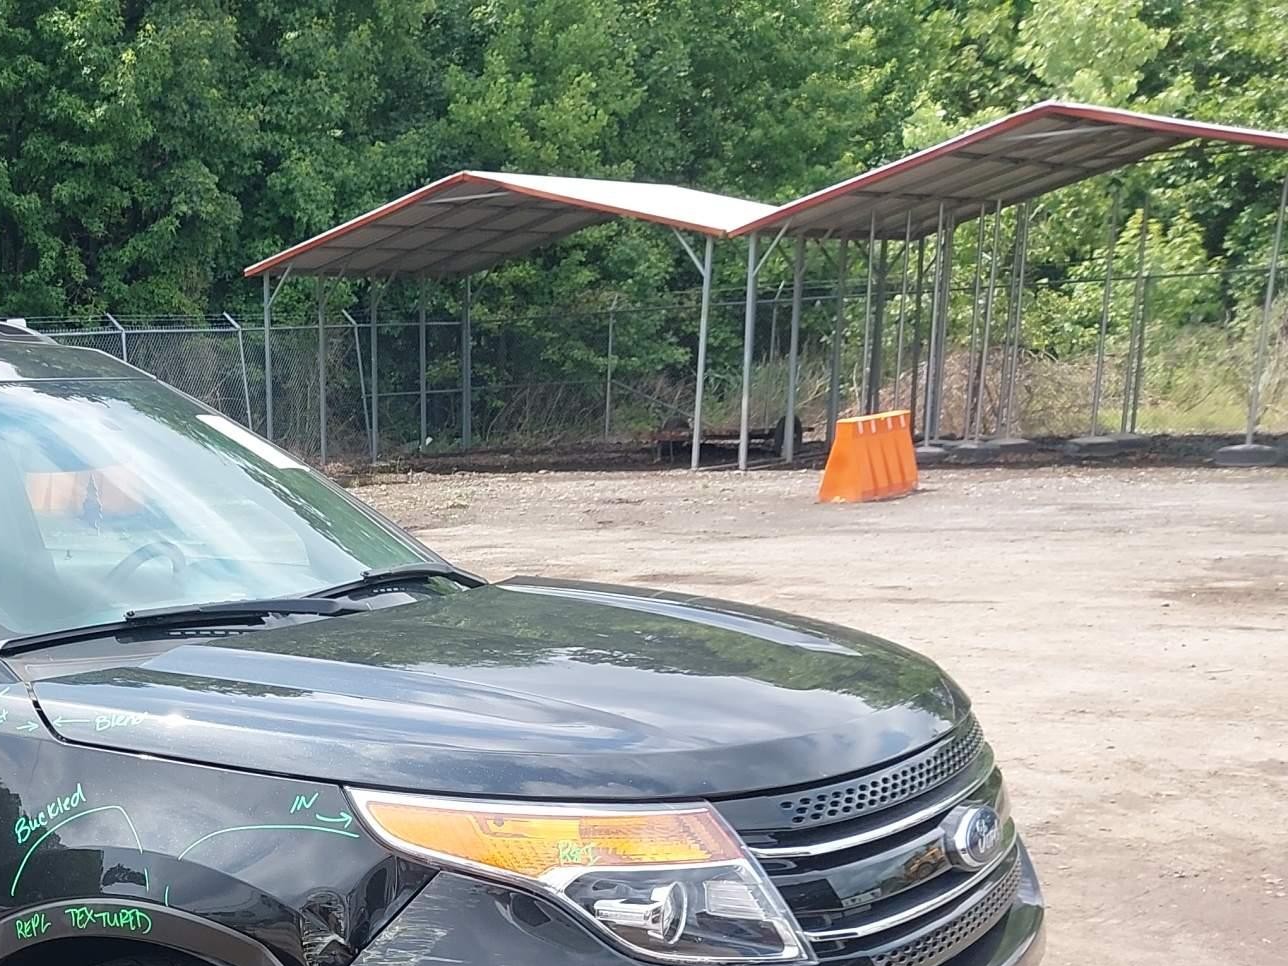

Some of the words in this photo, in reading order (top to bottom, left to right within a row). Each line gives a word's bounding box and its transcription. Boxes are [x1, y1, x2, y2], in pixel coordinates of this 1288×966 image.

[290, 792, 319, 814] IN
[16, 913, 52, 939] REPL
[65, 906, 152, 934] TEXTURED
